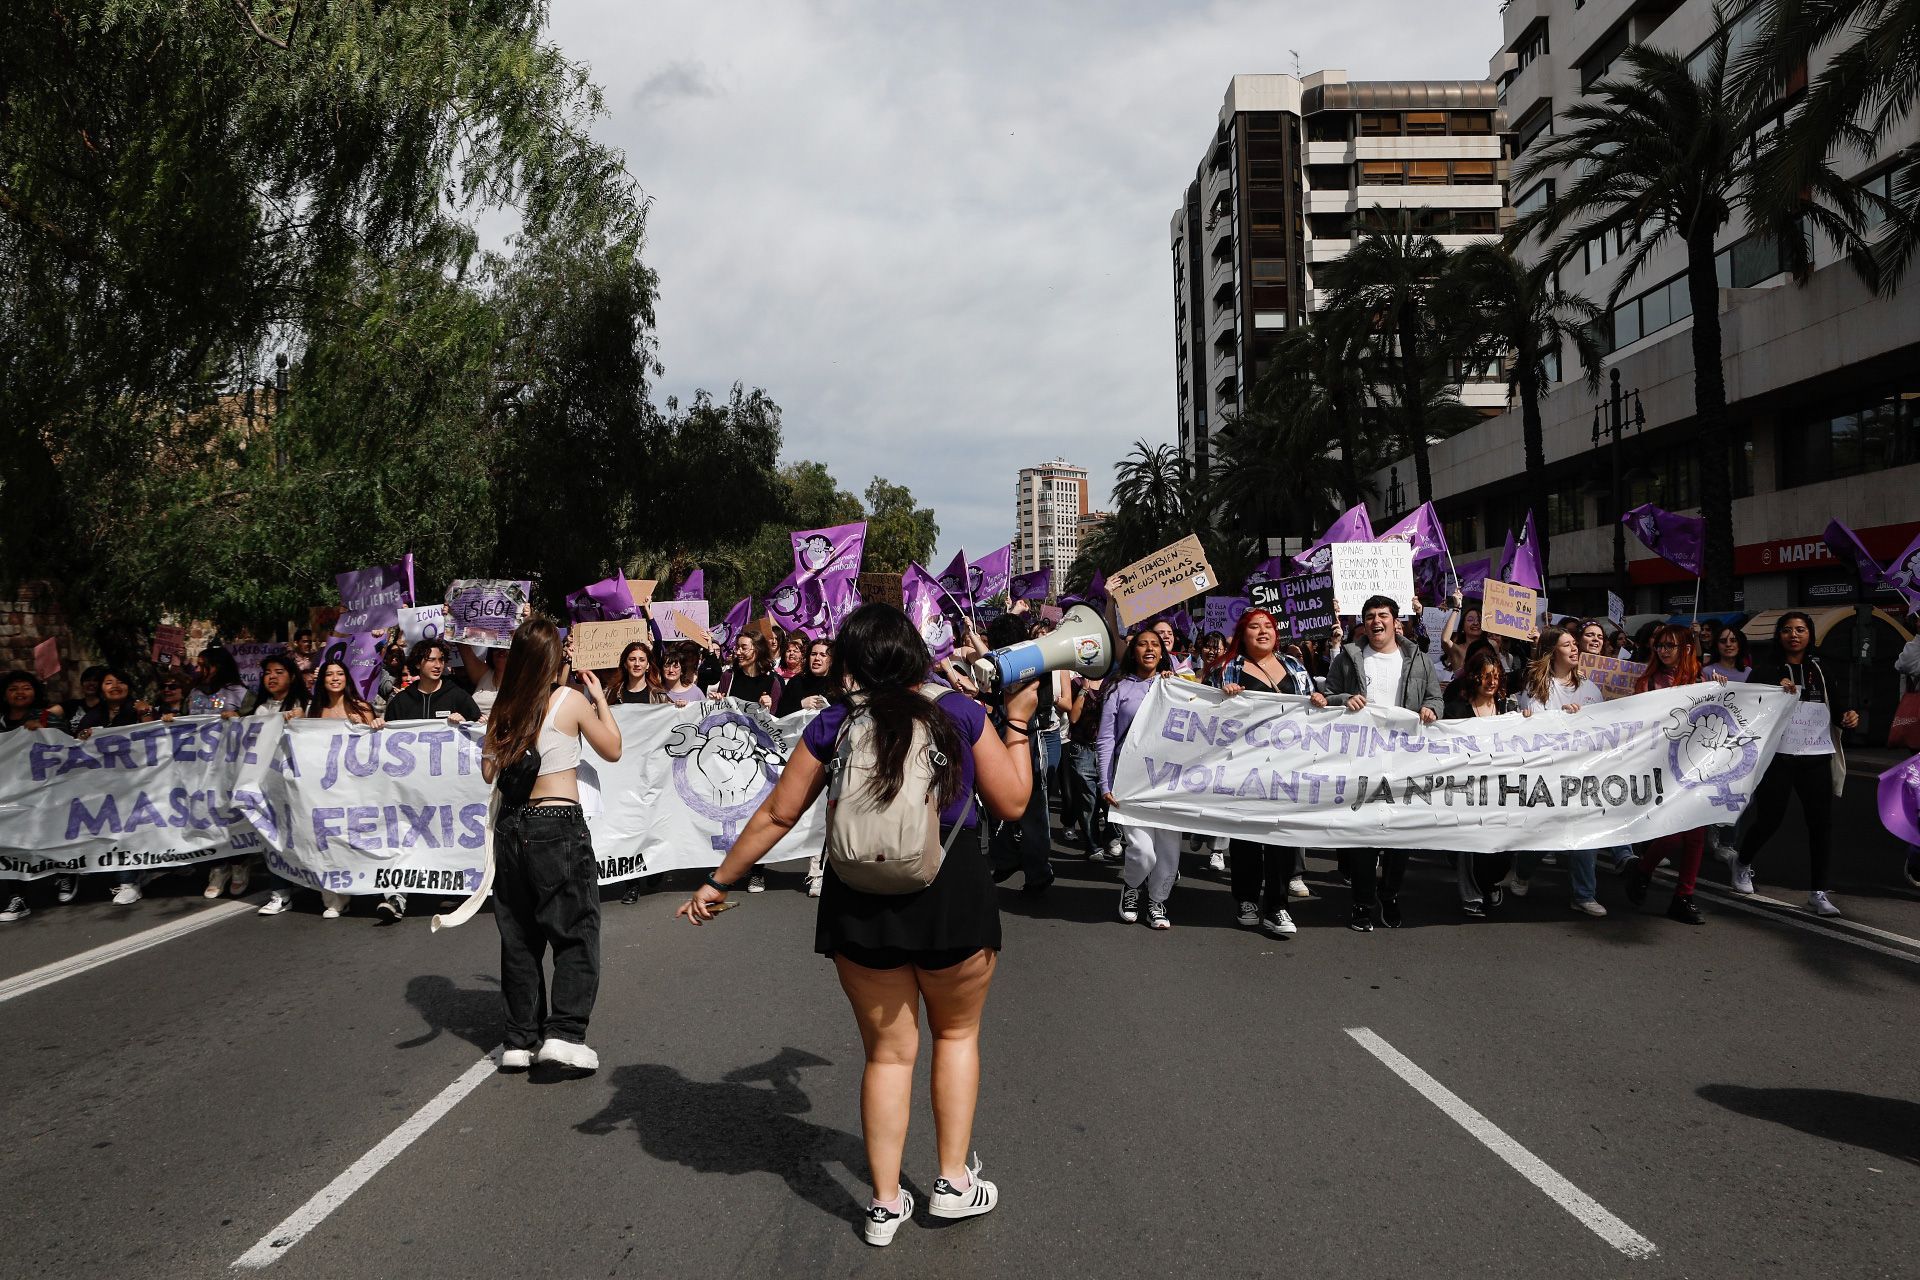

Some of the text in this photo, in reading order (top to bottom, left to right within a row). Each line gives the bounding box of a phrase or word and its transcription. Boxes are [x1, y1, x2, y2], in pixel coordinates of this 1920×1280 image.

[1337, 545, 1402, 556] OPINAS QUE EL
[1169, 573, 1184, 585] NO
[1185, 562, 1206, 577] LAS
[1382, 558, 1393, 568] NO
[1395, 557, 1405, 568] TE
[1123, 557, 1193, 596] ME GUSTAN LAS
[1340, 569, 1380, 580] REPRESENTA
[1392, 569, 1400, 580] TE
[1809, 586, 1830, 594] SEGUROS
[1837, 584, 1853, 592] SALUD
[1284, 597, 1323, 614] AULAS
[1290, 613, 1333, 639] EDUCACIÓN
[1495, 609, 1530, 631] DONES
[1162, 707, 1244, 747] ENS
[29, 721, 224, 781] FARTES
[224, 722, 265, 765] DE
[1144, 756, 1346, 805] VIOLANT!
[1351, 775, 1396, 812] JA
[1560, 767, 1664, 807] PROU!
[0, 855, 88, 875] Sindicat
[374, 867, 465, 891] ESQUERRA
